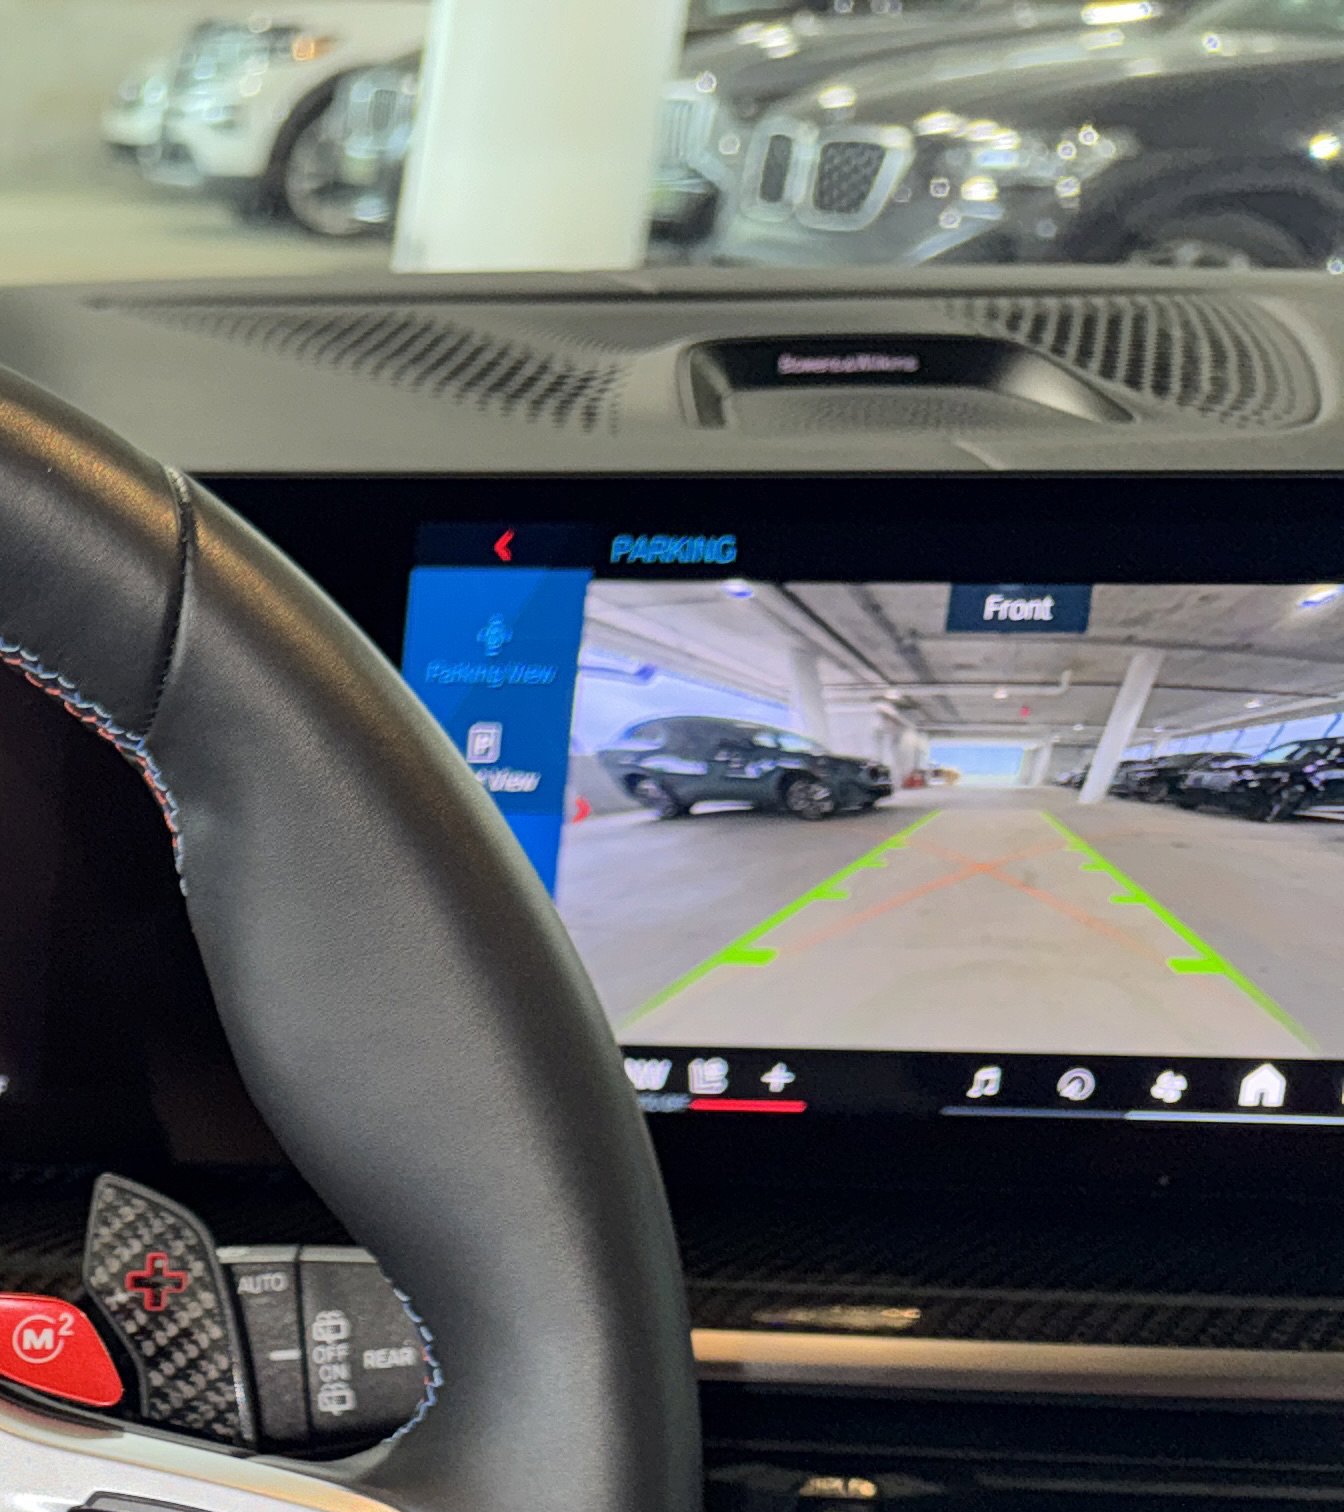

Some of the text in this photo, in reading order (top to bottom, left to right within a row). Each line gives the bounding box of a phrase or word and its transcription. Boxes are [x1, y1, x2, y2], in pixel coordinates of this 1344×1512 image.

[610, 534, 738, 564] PARKING
[983, 593, 1055, 622] Front
[237, 1272, 289, 1294] AUTO
[313, 1343, 350, 1365] OFF
[363, 1347, 417, 1370] REAR
[319, 1364, 351, 1383] ON
